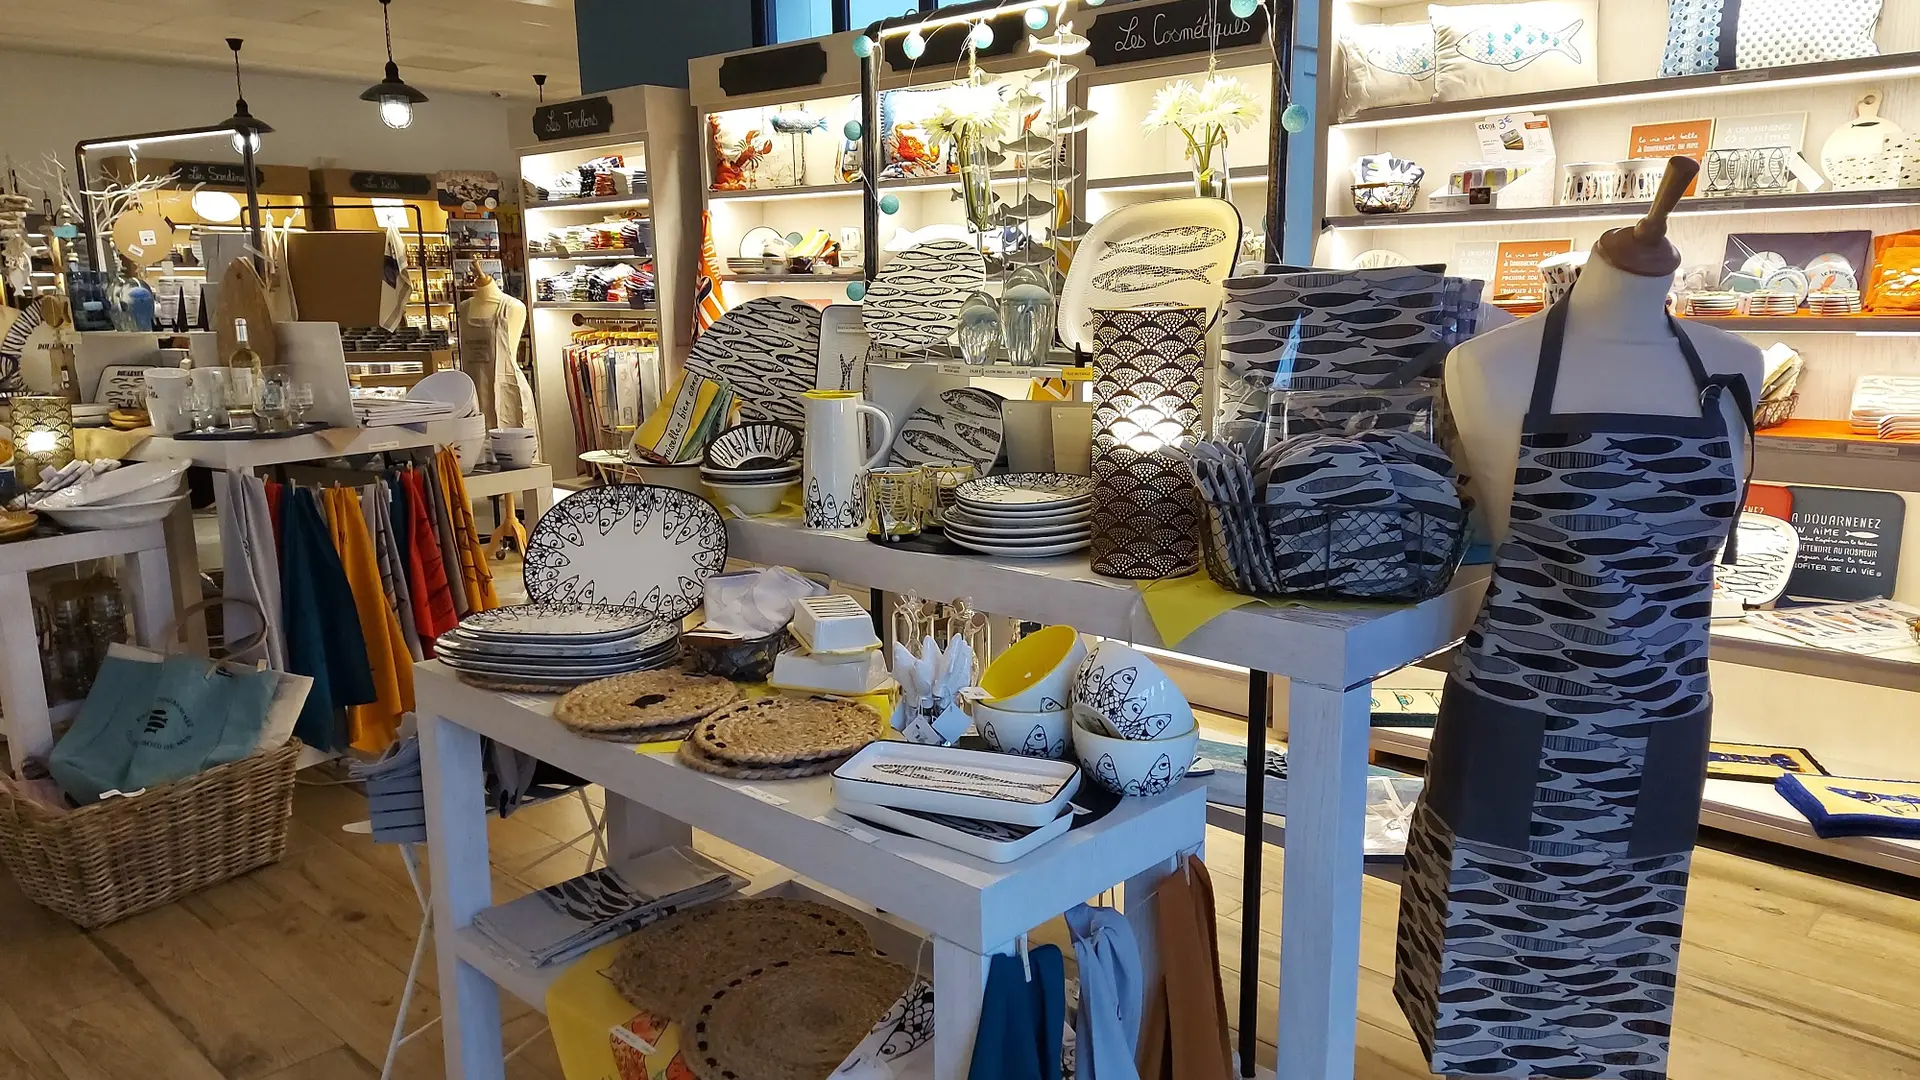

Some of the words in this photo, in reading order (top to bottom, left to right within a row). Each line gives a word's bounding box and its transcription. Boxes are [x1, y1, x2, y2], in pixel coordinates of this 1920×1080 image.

[1114, 16, 1147, 52] Les
[545, 109, 561, 132] Les
[563, 109, 598, 130] Torchons
[207, 166, 247, 182] Sardine
[676, 400, 691, 420] bien
[1791, 512, 1798, 523] A
[1804, 513, 1882, 529] DOUARNENEZ
[1824, 555, 1844, 563] dans
[1833, 546, 1843, 555] AU
[1844, 547, 1878, 558] ROSMEUR
[1795, 562, 1827, 572] OFiTER
[1830, 565, 1842, 573] DE
